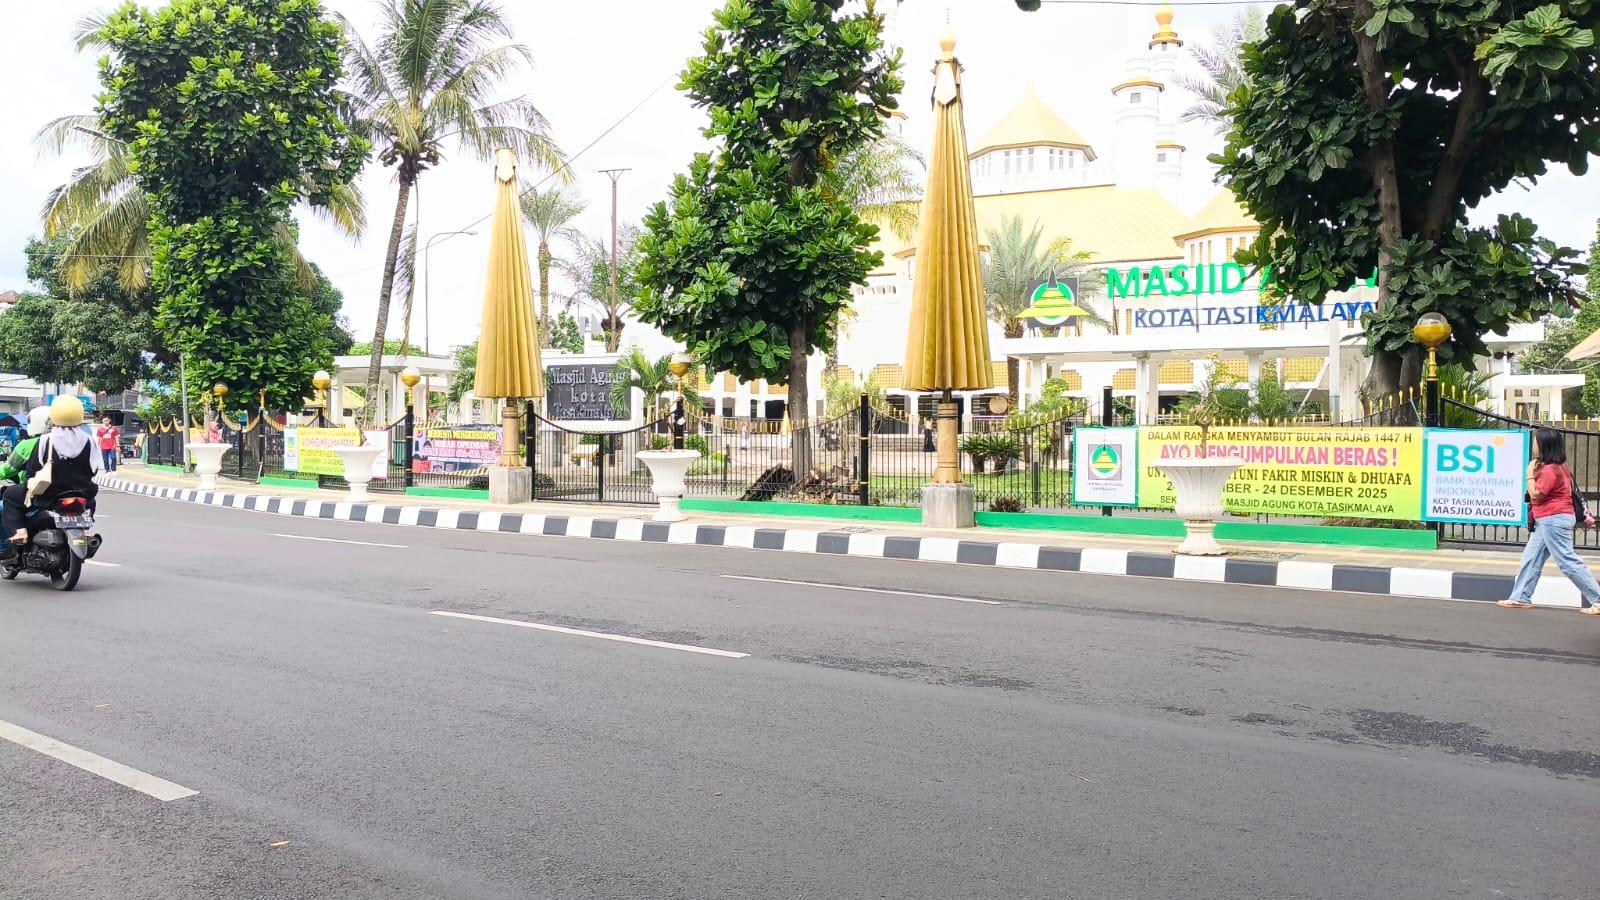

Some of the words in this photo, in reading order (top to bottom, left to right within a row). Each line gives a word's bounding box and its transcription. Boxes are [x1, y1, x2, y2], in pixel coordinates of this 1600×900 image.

[1107, 263, 1246, 298] MASJID
[1135, 308, 1195, 327] KOTA
[1203, 302, 1375, 325] TASIKMALAYA
[550, 367, 585, 386] Masjid
[571, 387, 605, 402] kota
[1148, 431, 1181, 440] DALAM
[1184, 431, 1224, 441] RANGKA
[1227, 432, 1293, 442] MENYAMBUT
[1296, 432, 1331, 442] BULAN
[1335, 432, 1370, 442] RAJAB
[1375, 433, 1400, 443] 1447
[1404, 433, 1412, 443] H
[1161, 445, 1190, 459] AYO
[1334, 446, 1388, 466] BERAS
[1437, 444, 1494, 473] BSI
[1262, 469, 1297, 482] FAKIR
[1301, 470, 1344, 483] MISKIN
[1348, 472, 1357, 483] &
[1361, 472, 1412, 485] DHUAFA
[1435, 476, 1465, 485] BANK
[1468, 477, 1514, 487] SYARIAH
[1263, 485, 1277, 495] 24
[1280, 485, 1353, 497] DESEMBER
[1357, 487, 1388, 498] 2025
[1435, 487, 1496, 496] INDONESIA
[1226, 498, 1259, 508] MASJID
[1262, 499, 1296, 509] AGUNG
[1299, 501, 1324, 511] KOTA
[1327, 502, 1395, 513] TASIKMALAYA
[1452, 498, 1512, 507] TASIKMALAYA
[1432, 506, 1473, 515] MASJID
[1475, 508, 1516, 517] AGUNG
